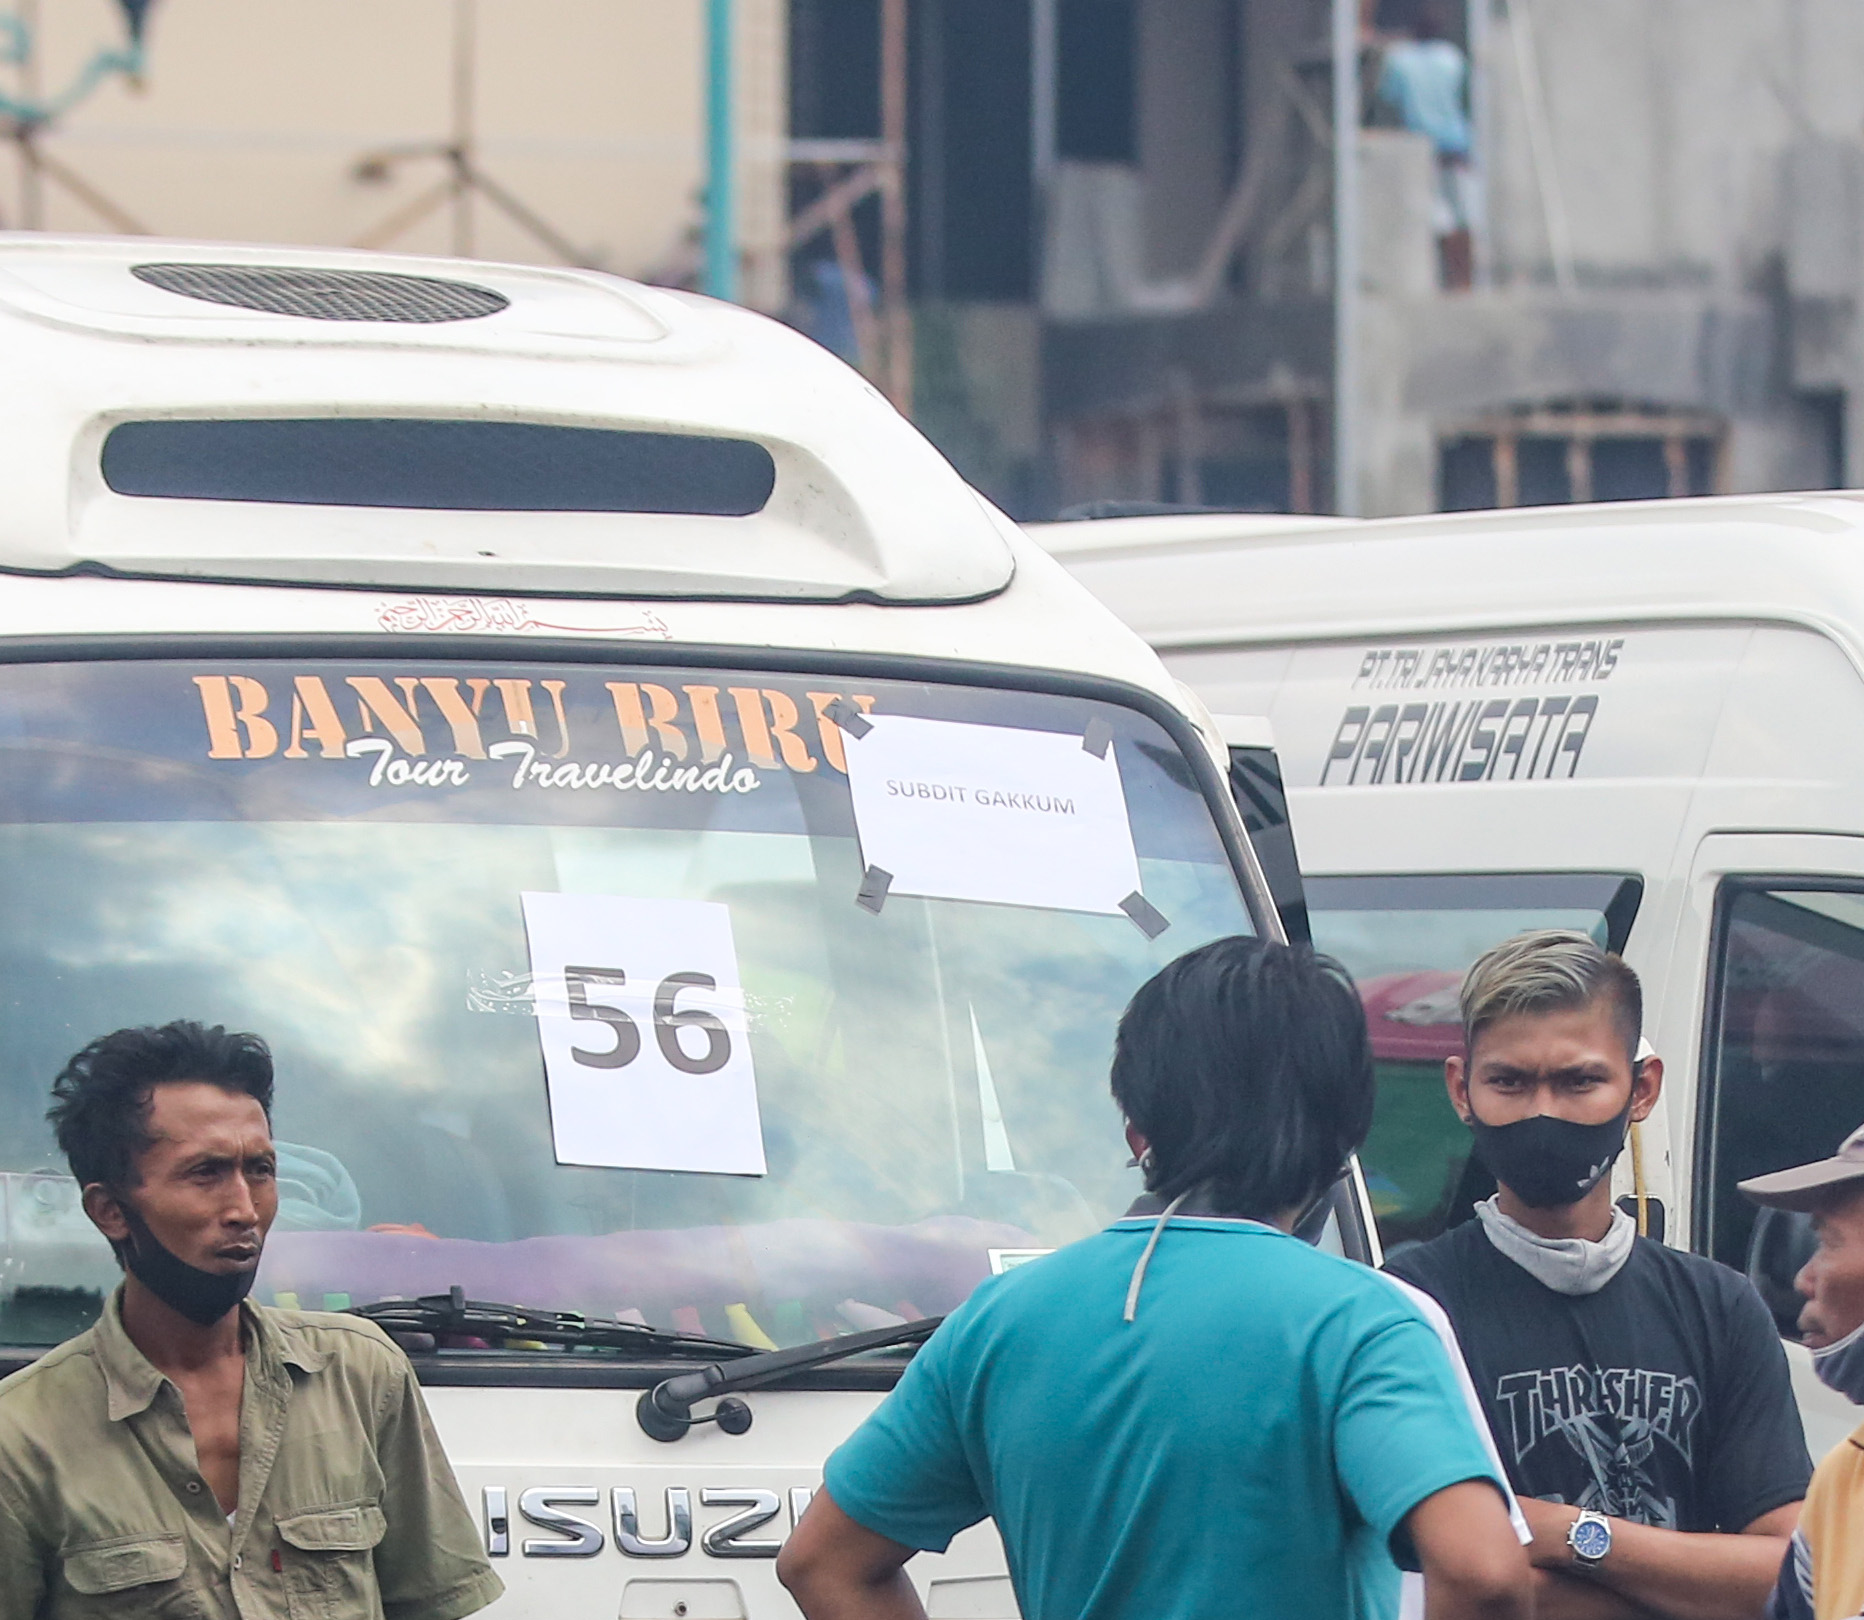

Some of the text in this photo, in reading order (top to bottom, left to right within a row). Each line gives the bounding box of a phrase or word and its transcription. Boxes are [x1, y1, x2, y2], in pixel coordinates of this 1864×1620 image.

[193, 675, 568, 759] BANYU
[1318, 693, 1600, 787] PARIWISATA
[347, 738, 761, 794] Tour Travelindo
[885, 778, 1077, 816] SUBDIT GAKKUM
[563, 964, 733, 1076] 56
[1496, 1363, 1703, 1468] THRASHER
